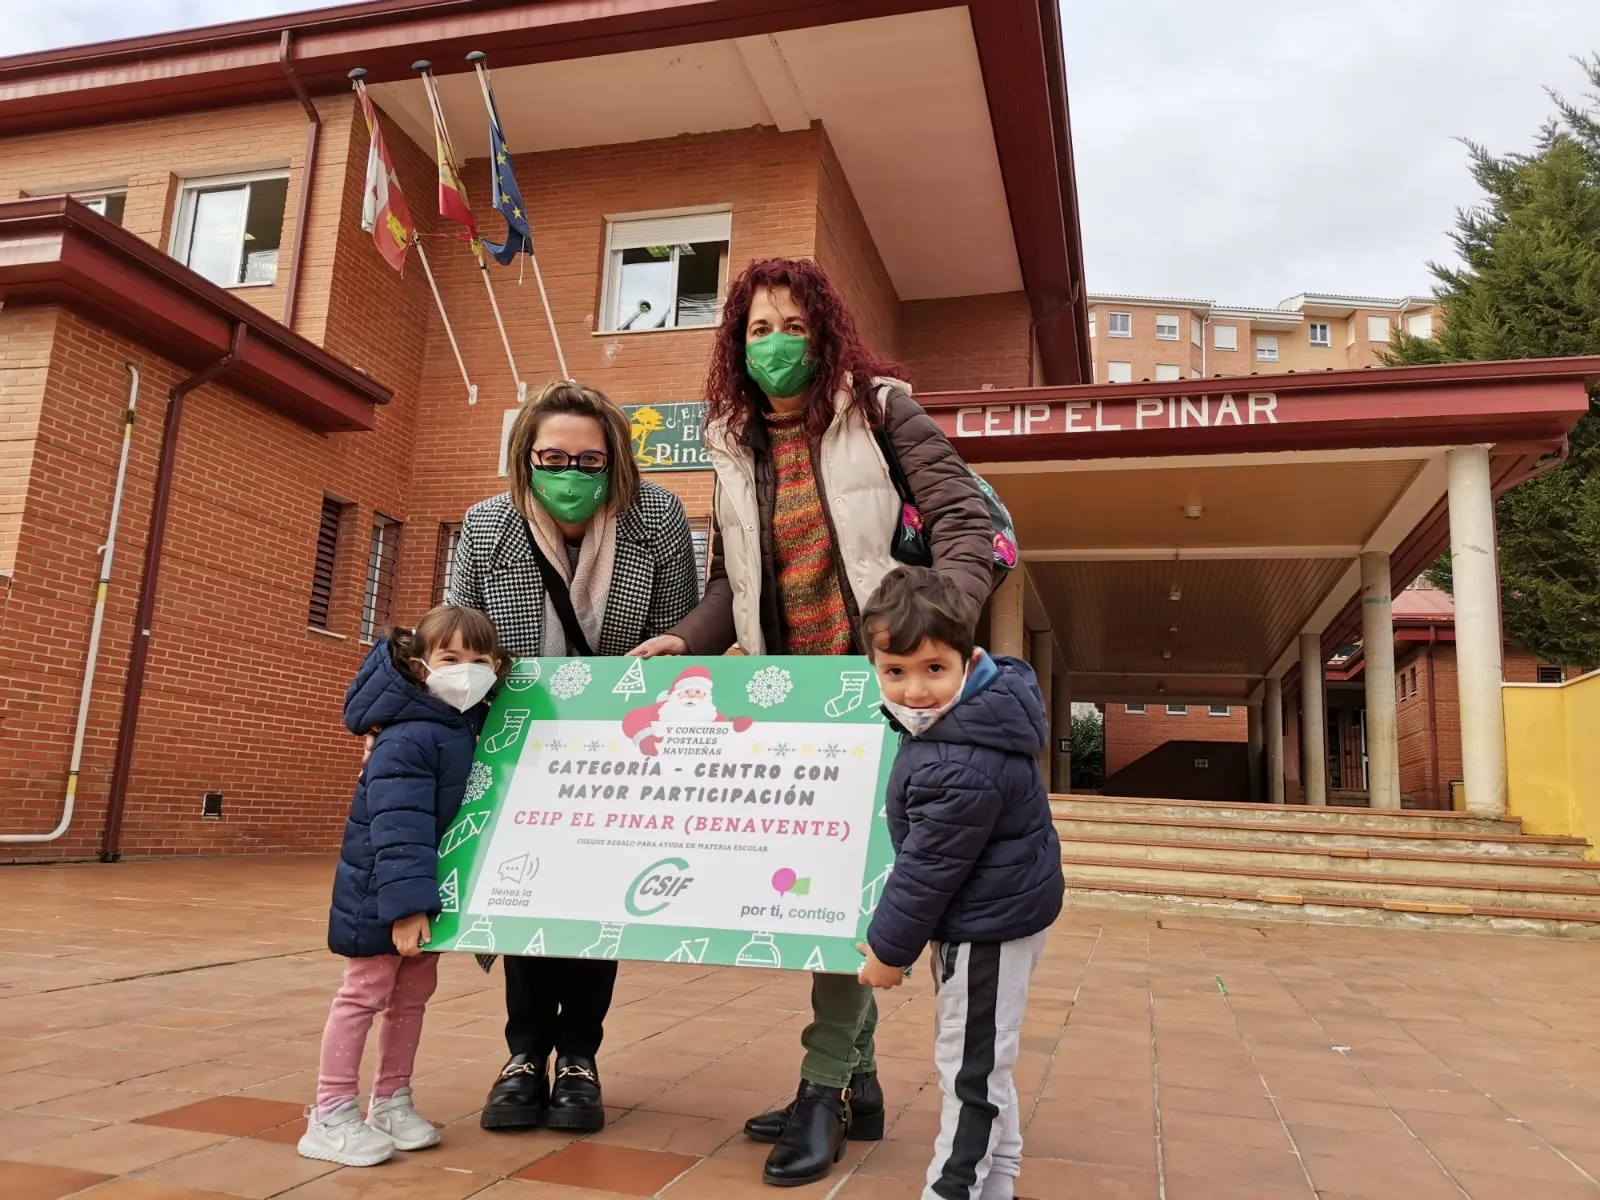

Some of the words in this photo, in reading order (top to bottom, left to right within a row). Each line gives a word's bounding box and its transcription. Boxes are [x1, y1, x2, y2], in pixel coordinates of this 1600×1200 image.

[956, 403, 1050, 437] CEIP
[1065, 401, 1121, 433] EL
[1135, 391, 1278, 430] PINAR
[655, 443, 713, 464] Pina
[666, 727, 672, 735] V
[676, 727, 729, 735] CONCURSO
[667, 737, 718, 745] POSTALES
[662, 746, 722, 756] NAVIDEÑAS
[548, 757, 661, 777] CATEGORÍA
[694, 762, 782, 780] CENTRO
[794, 765, 840, 782] CON
[558, 784, 629, 800] MAYOR
[640, 784, 815, 806] PARTICIPACIÓN
[513, 810, 563, 827] CEIP
[570, 812, 596, 827] EL
[604, 813, 675, 830] PINAR
[684, 815, 850, 842] (BENAVENTE)
[577, 838, 605, 847] CHEQUE
[606, 839, 636, 847] REGALO
[637, 840, 656, 848] PARA
[658, 841, 684, 849] AYUDA
[697, 842, 732, 850] MATERIA
[733, 844, 769, 852] ESCOLAR
[491, 887, 520, 897] tienes
[522, 888, 532, 897] la
[639, 874, 695, 897] CSIF
[487, 896, 530, 907] palabra
[740, 905, 767, 918] por
[770, 904, 784, 918] ti,
[788, 906, 846, 923] contigo
